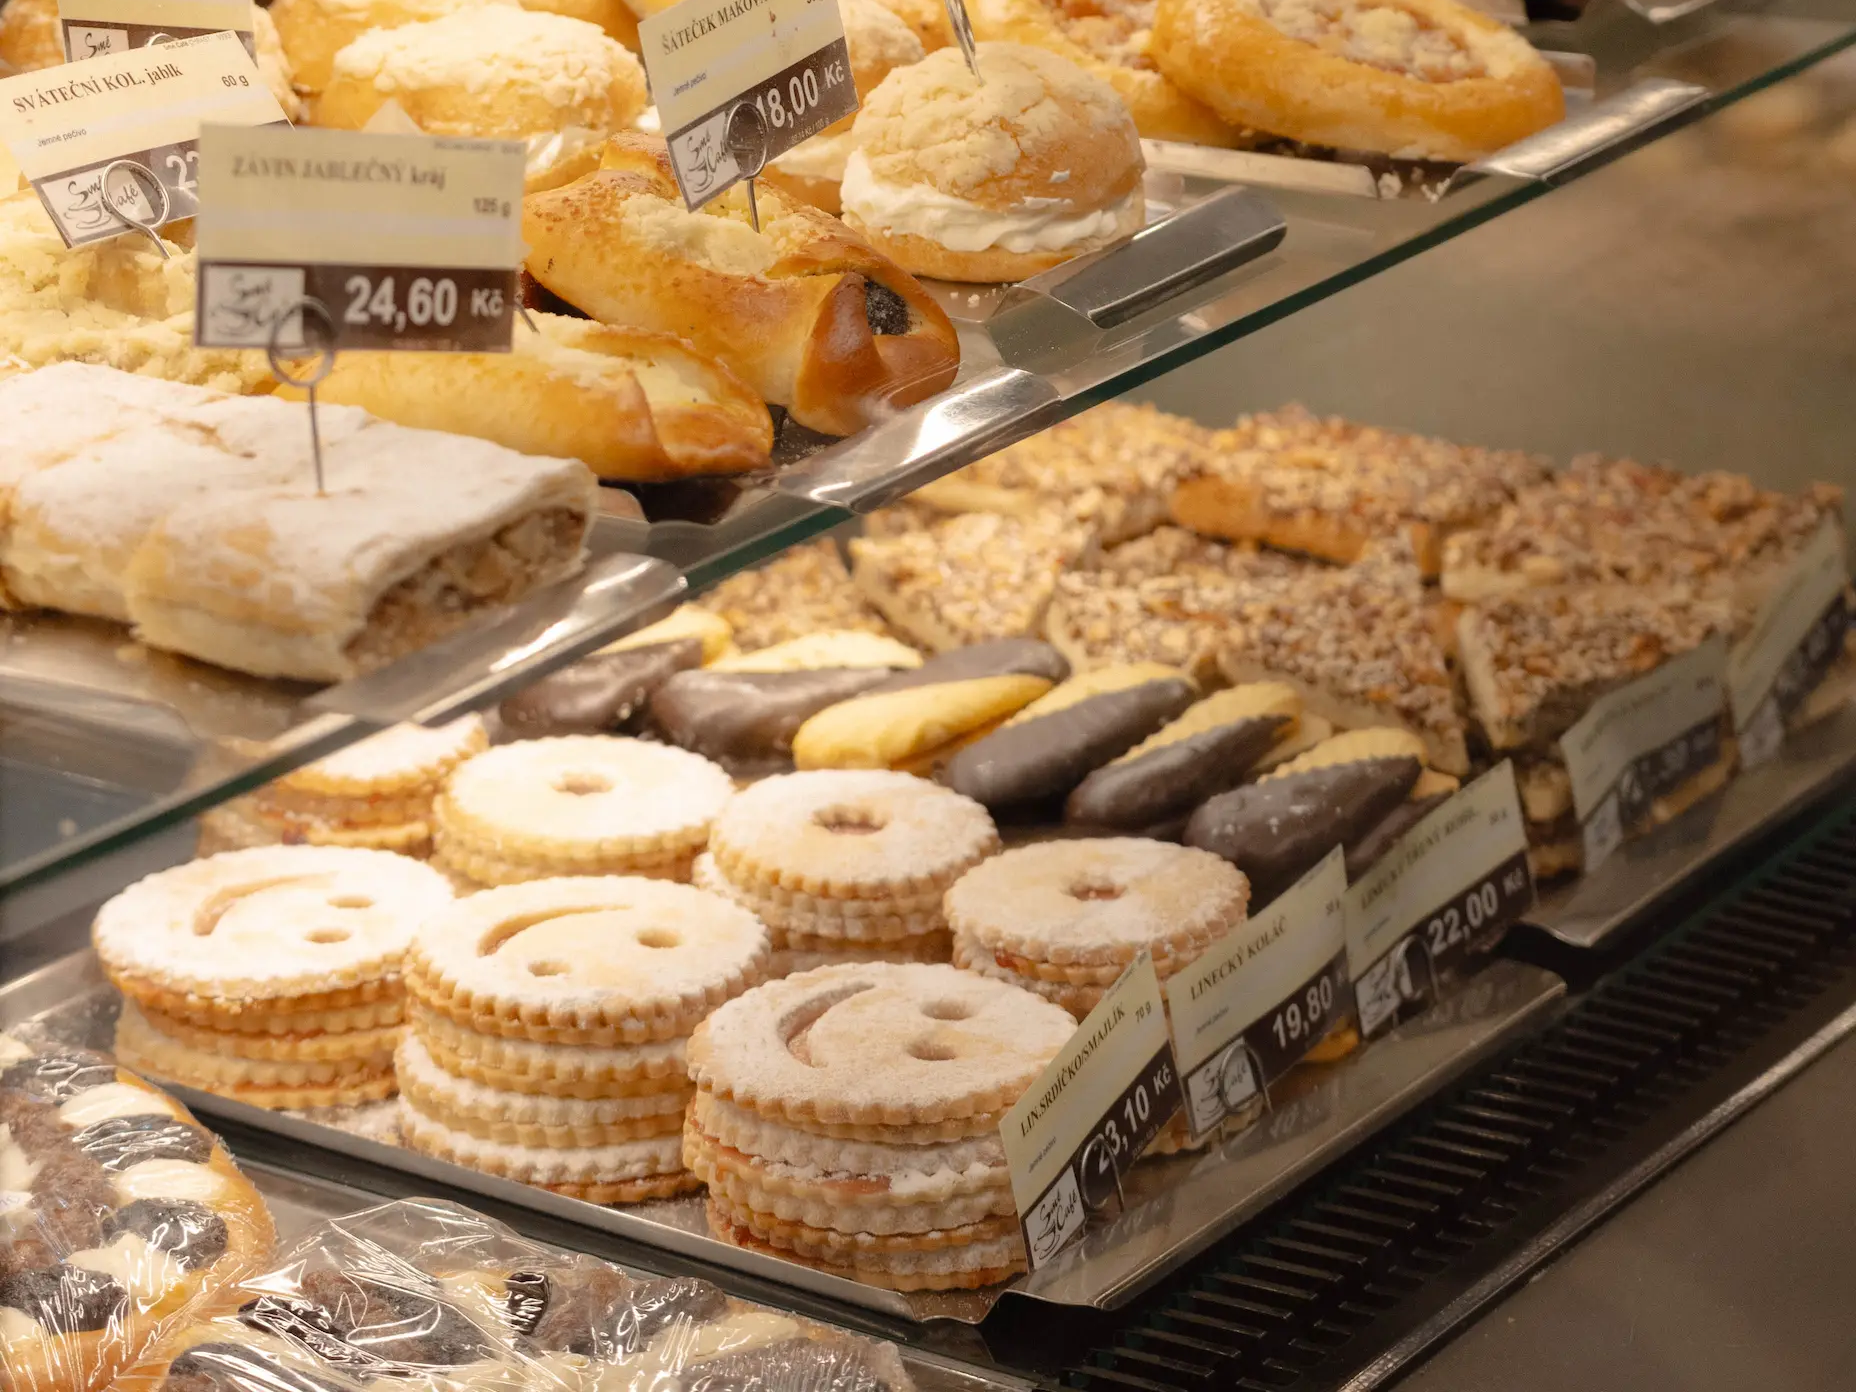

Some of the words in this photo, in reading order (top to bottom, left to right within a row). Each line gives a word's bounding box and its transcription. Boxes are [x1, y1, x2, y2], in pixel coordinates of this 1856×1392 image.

[661, 13, 717, 56] ŠÁTEČEK
[12, 78, 103, 113] SVÁTEČNÍ
[102, 70, 146, 93] KOL.
[147, 63, 183, 86] jablk
[221, 75, 236, 88] 60
[239, 74, 249, 87] g
[756, 68, 819, 133] 18,00
[824, 60, 845, 88] Kč
[37, 133, 62, 148] Jemné
[63, 128, 87, 143] pečivo
[344, 274, 459, 333] 24,60
[470, 288, 505, 318] Kč
[1427, 881, 1499, 957] 22,00
[1272, 974, 1333, 1051] 19,80
[1094, 1084, 1150, 1175] 23,10
[1153, 1062, 1173, 1092] Kč
